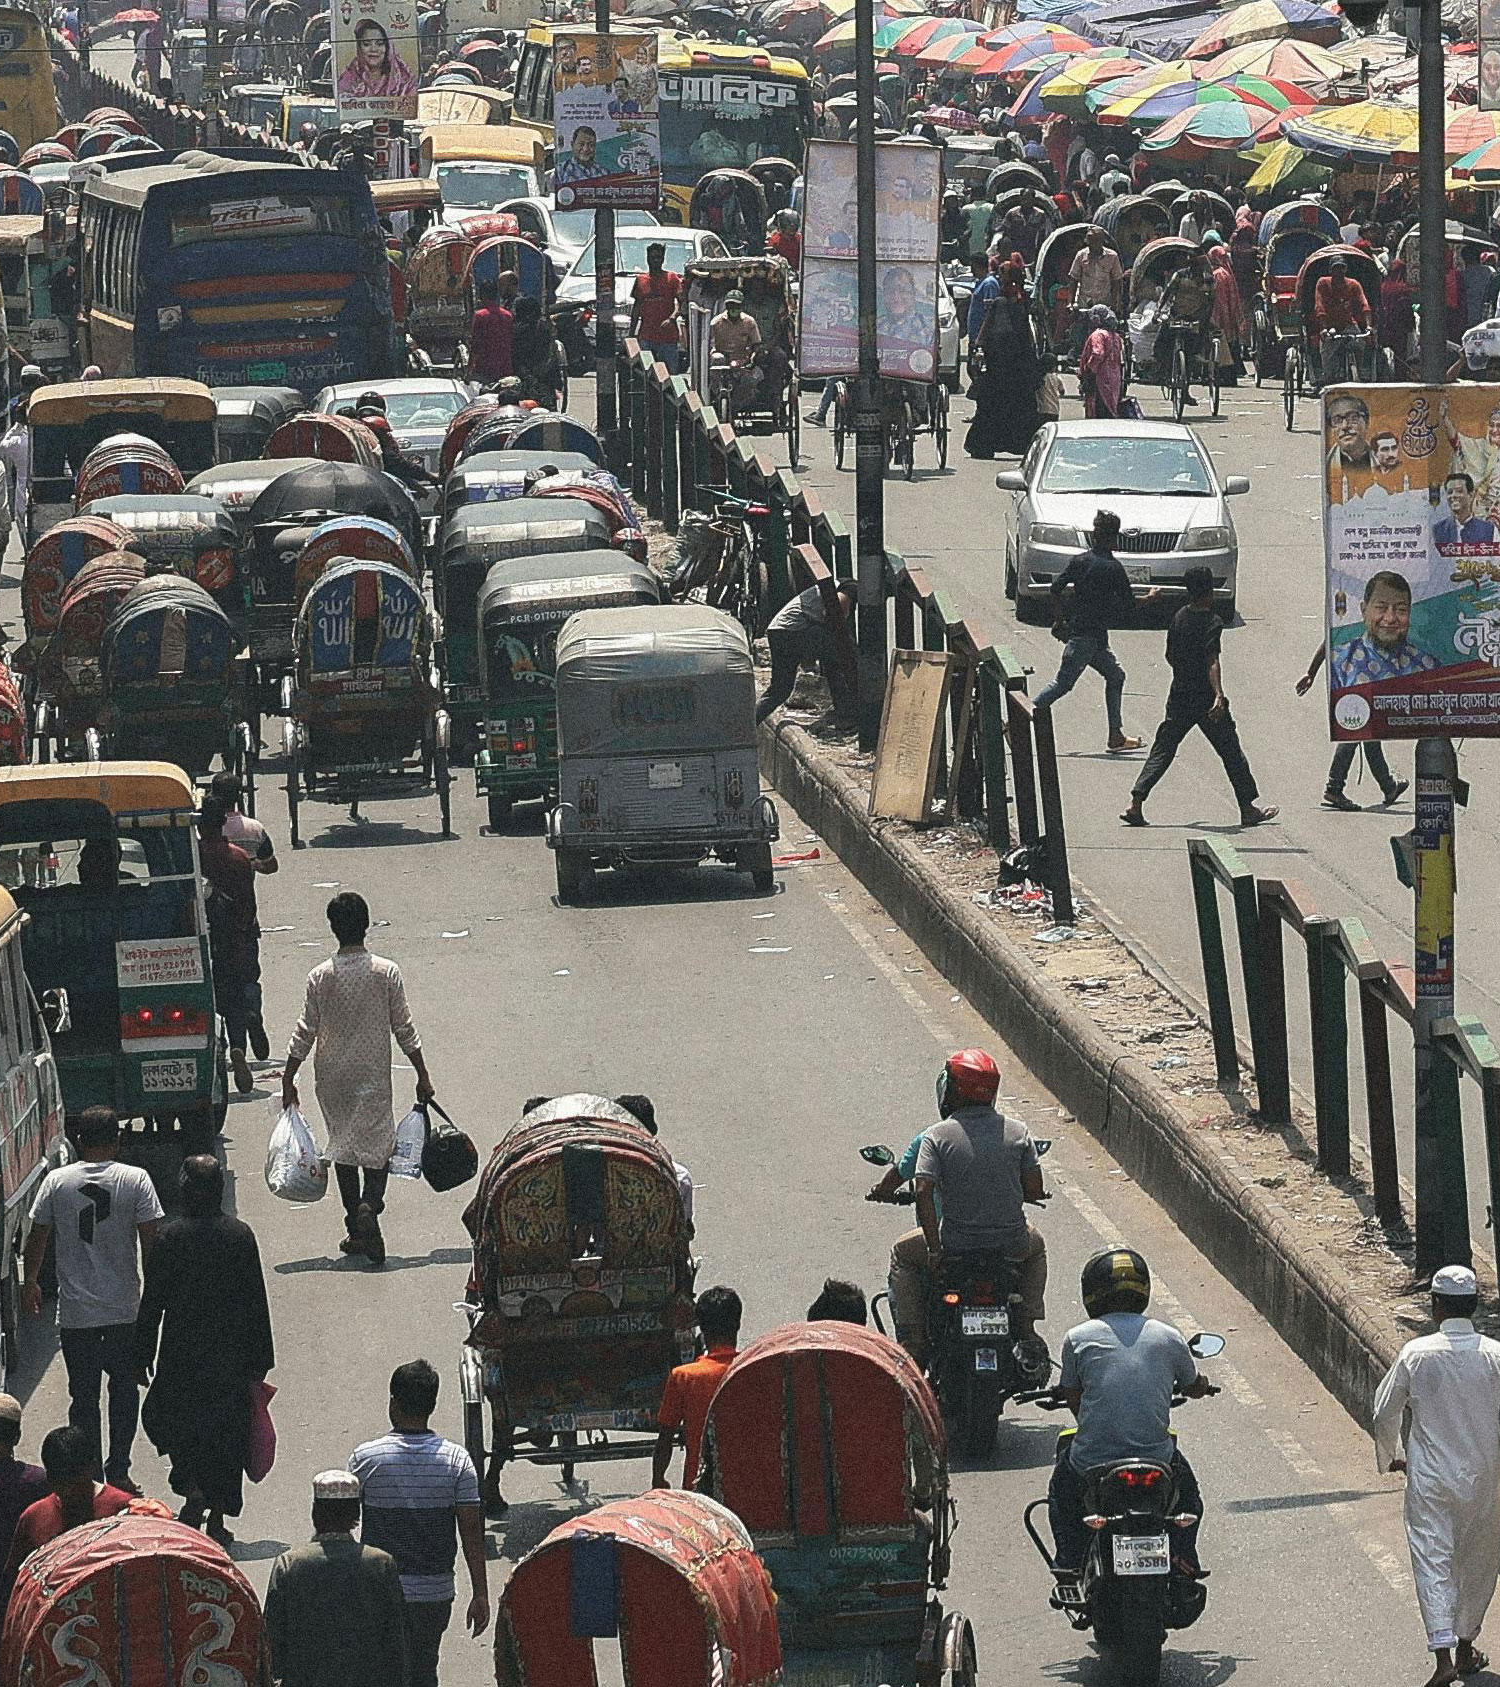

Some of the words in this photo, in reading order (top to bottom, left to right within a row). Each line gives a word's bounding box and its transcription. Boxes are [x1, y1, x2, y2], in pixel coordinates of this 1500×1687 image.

[1411, 695, 1428, 710] মোঃ
[1429, 691, 1458, 714] মাইনুল
[1460, 693, 1487, 710] হোসেন
